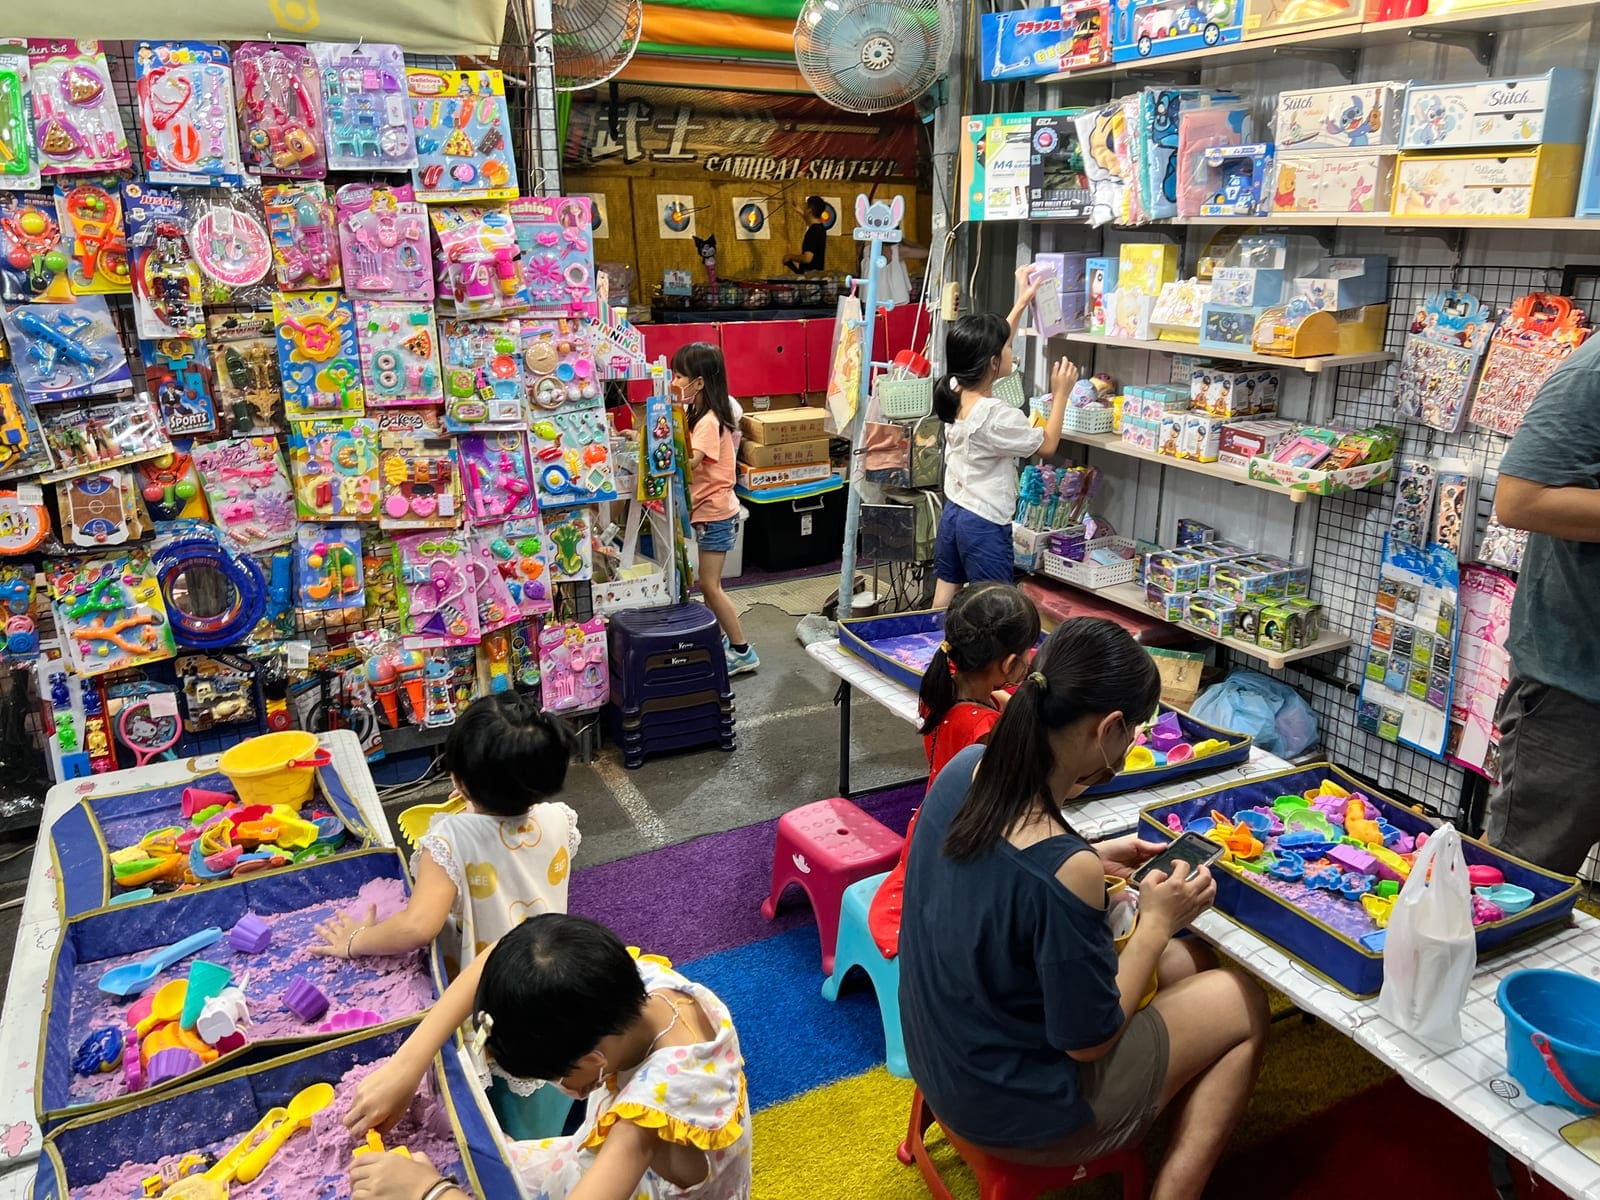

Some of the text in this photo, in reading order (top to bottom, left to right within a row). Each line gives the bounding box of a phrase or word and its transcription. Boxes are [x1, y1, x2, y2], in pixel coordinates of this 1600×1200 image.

[1281, 96, 1314, 112] Stitch
[1488, 89, 1530, 107] Stitch
[993, 159, 1014, 170] M4
[510, 202, 553, 216] ashion
[170, 411, 208, 429] SPORTS
